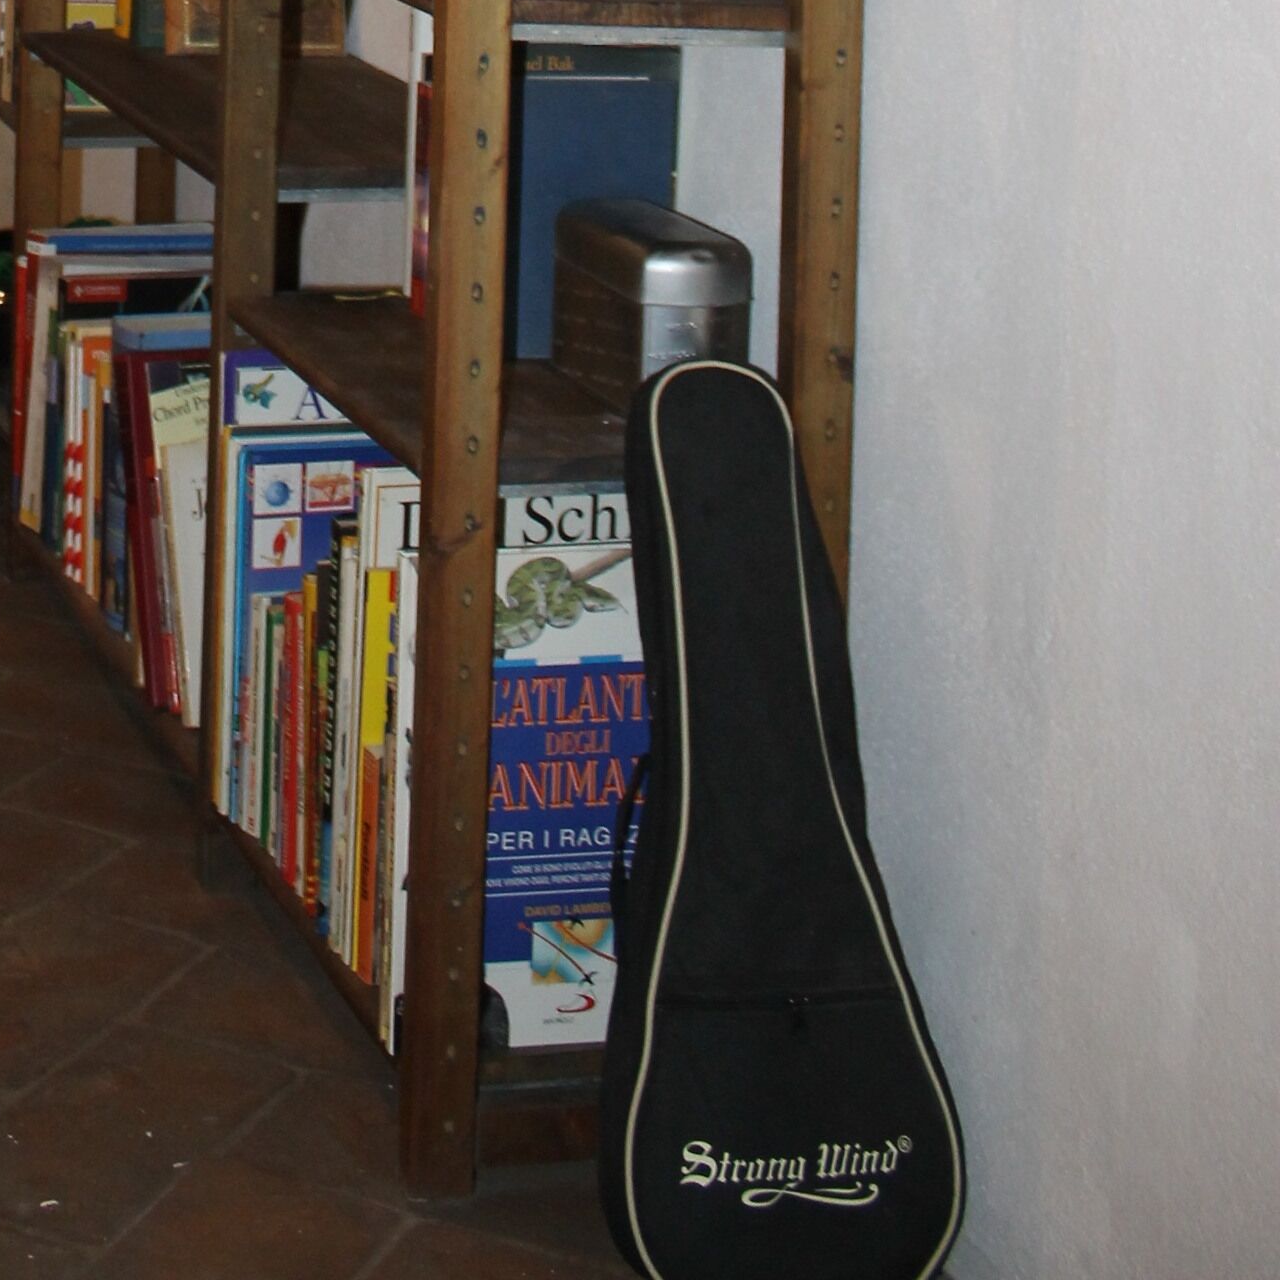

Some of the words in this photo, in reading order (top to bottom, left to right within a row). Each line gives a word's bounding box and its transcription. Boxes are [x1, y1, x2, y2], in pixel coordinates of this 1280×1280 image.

[522, 492, 620, 545] Sch
[491, 673, 647, 728] L'ATLANT
[545, 728, 612, 756] DEGLI
[679, 1140, 807, 1188] Strong
[816, 1139, 899, 1180] Wind
